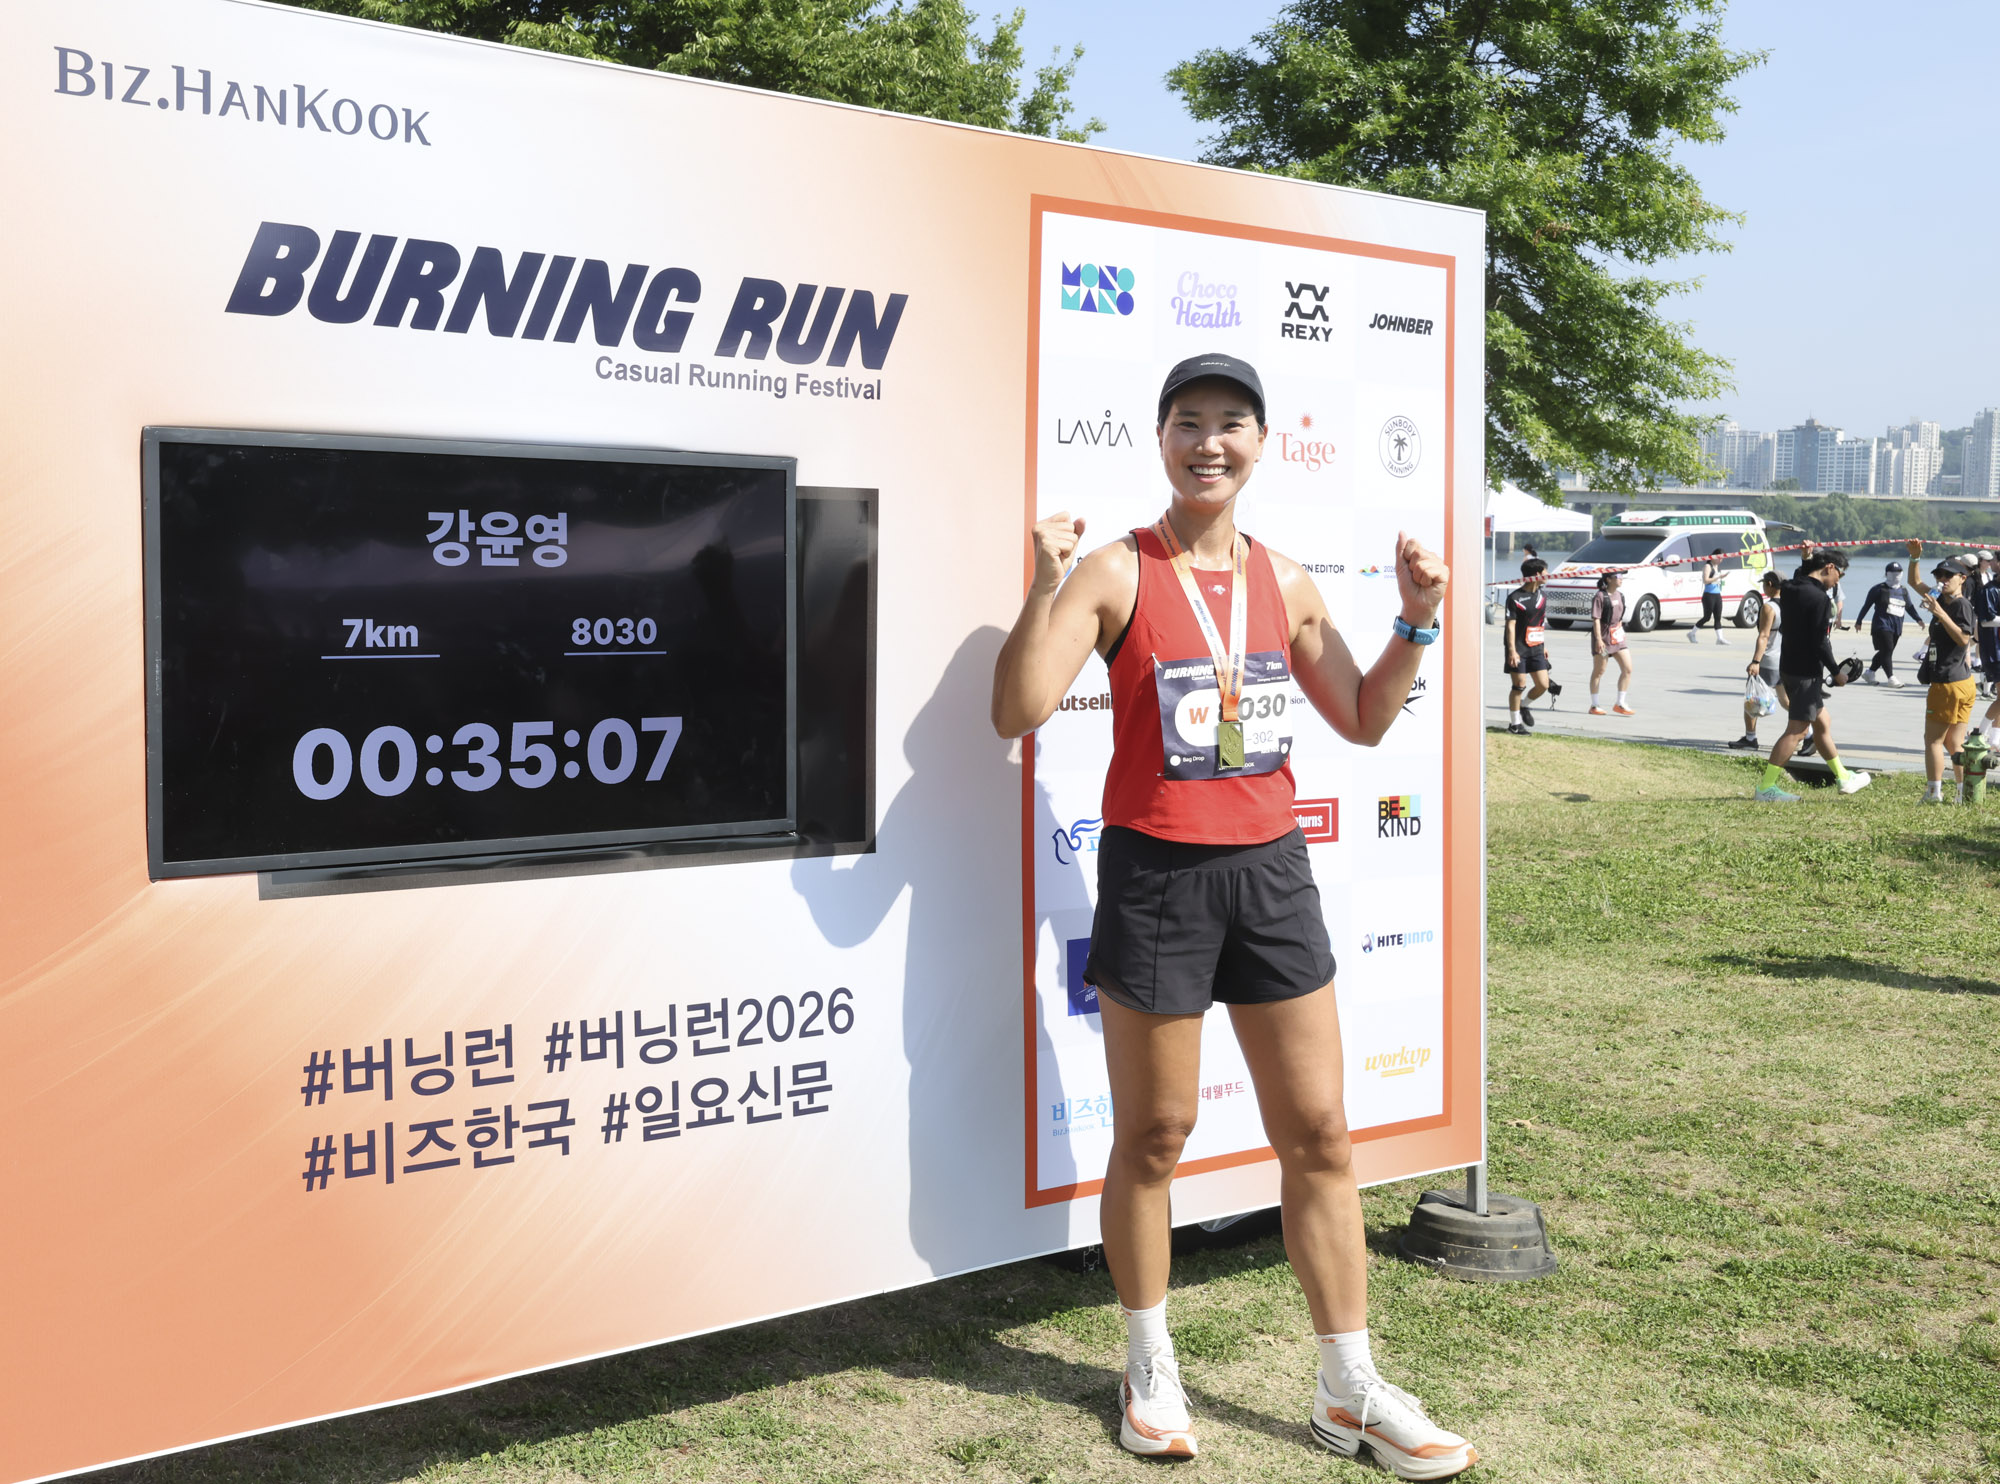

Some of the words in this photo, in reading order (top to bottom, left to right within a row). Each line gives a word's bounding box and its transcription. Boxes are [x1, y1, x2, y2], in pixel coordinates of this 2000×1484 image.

[225, 221, 702, 353] BURNING
[714, 276, 909, 371] RUN
[1177, 271, 1238, 299] Choco
[1171, 297, 1242, 328] Health
[1369, 313, 1433, 336] JOHNBER
[1281, 322, 1333, 342] REXY
[595, 356, 681, 386] Casual
[689, 362, 787, 399] Running
[796, 372, 882, 400] Festival
[1385, 419, 1416, 436] SUNBODY
[1276, 432, 1336, 472] Tage
[1387, 460, 1414, 474] TANNING
[426, 510, 569, 567] 강윤영
[1314, 564, 1345, 574] EDITOR
[342, 618, 420, 649] 7km
[571, 617, 658, 647] 8030
[1266, 661, 1283, 671] 7km
[1055, 692, 1112, 712] utseli
[1189, 707, 1209, 724] W
[1218, 693, 1286, 722] 030
[292, 716, 683, 801] 00:35:07
[1378, 800, 1405, 820] BE-
[1378, 816, 1421, 838] KIND
[301, 1024, 515, 1107] #버닝런
[543, 987, 854, 1074] #버닝런2026
[1198, 1081, 1246, 1100] 데웰푸드
[302, 1098, 576, 1192] #비즈한국
[601, 1060, 833, 1144] #일요신문
